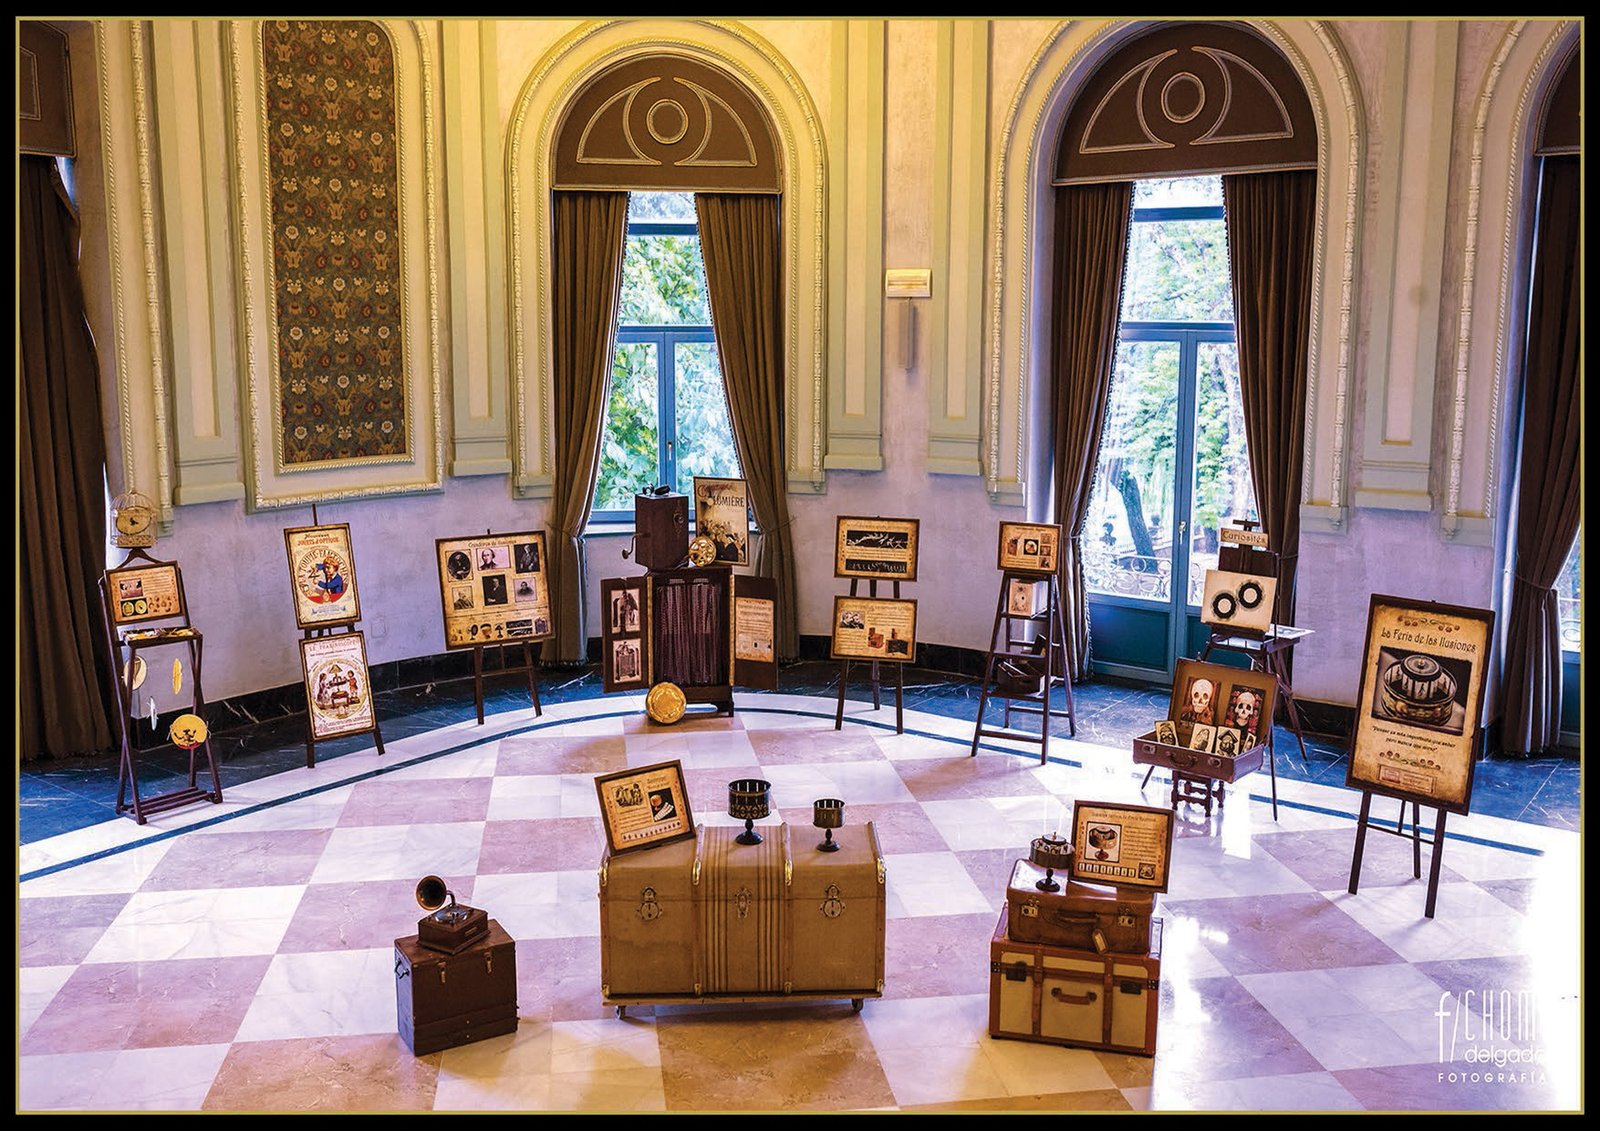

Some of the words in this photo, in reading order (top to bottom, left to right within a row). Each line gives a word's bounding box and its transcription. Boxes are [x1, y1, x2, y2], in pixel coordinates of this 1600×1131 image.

[1381, 627, 1391, 639] La
[1393, 628, 1412, 642] Feria
[1414, 633, 1425, 644] de
[1425, 635, 1438, 646] las
[1439, 637, 1477, 653] Ilusiones
